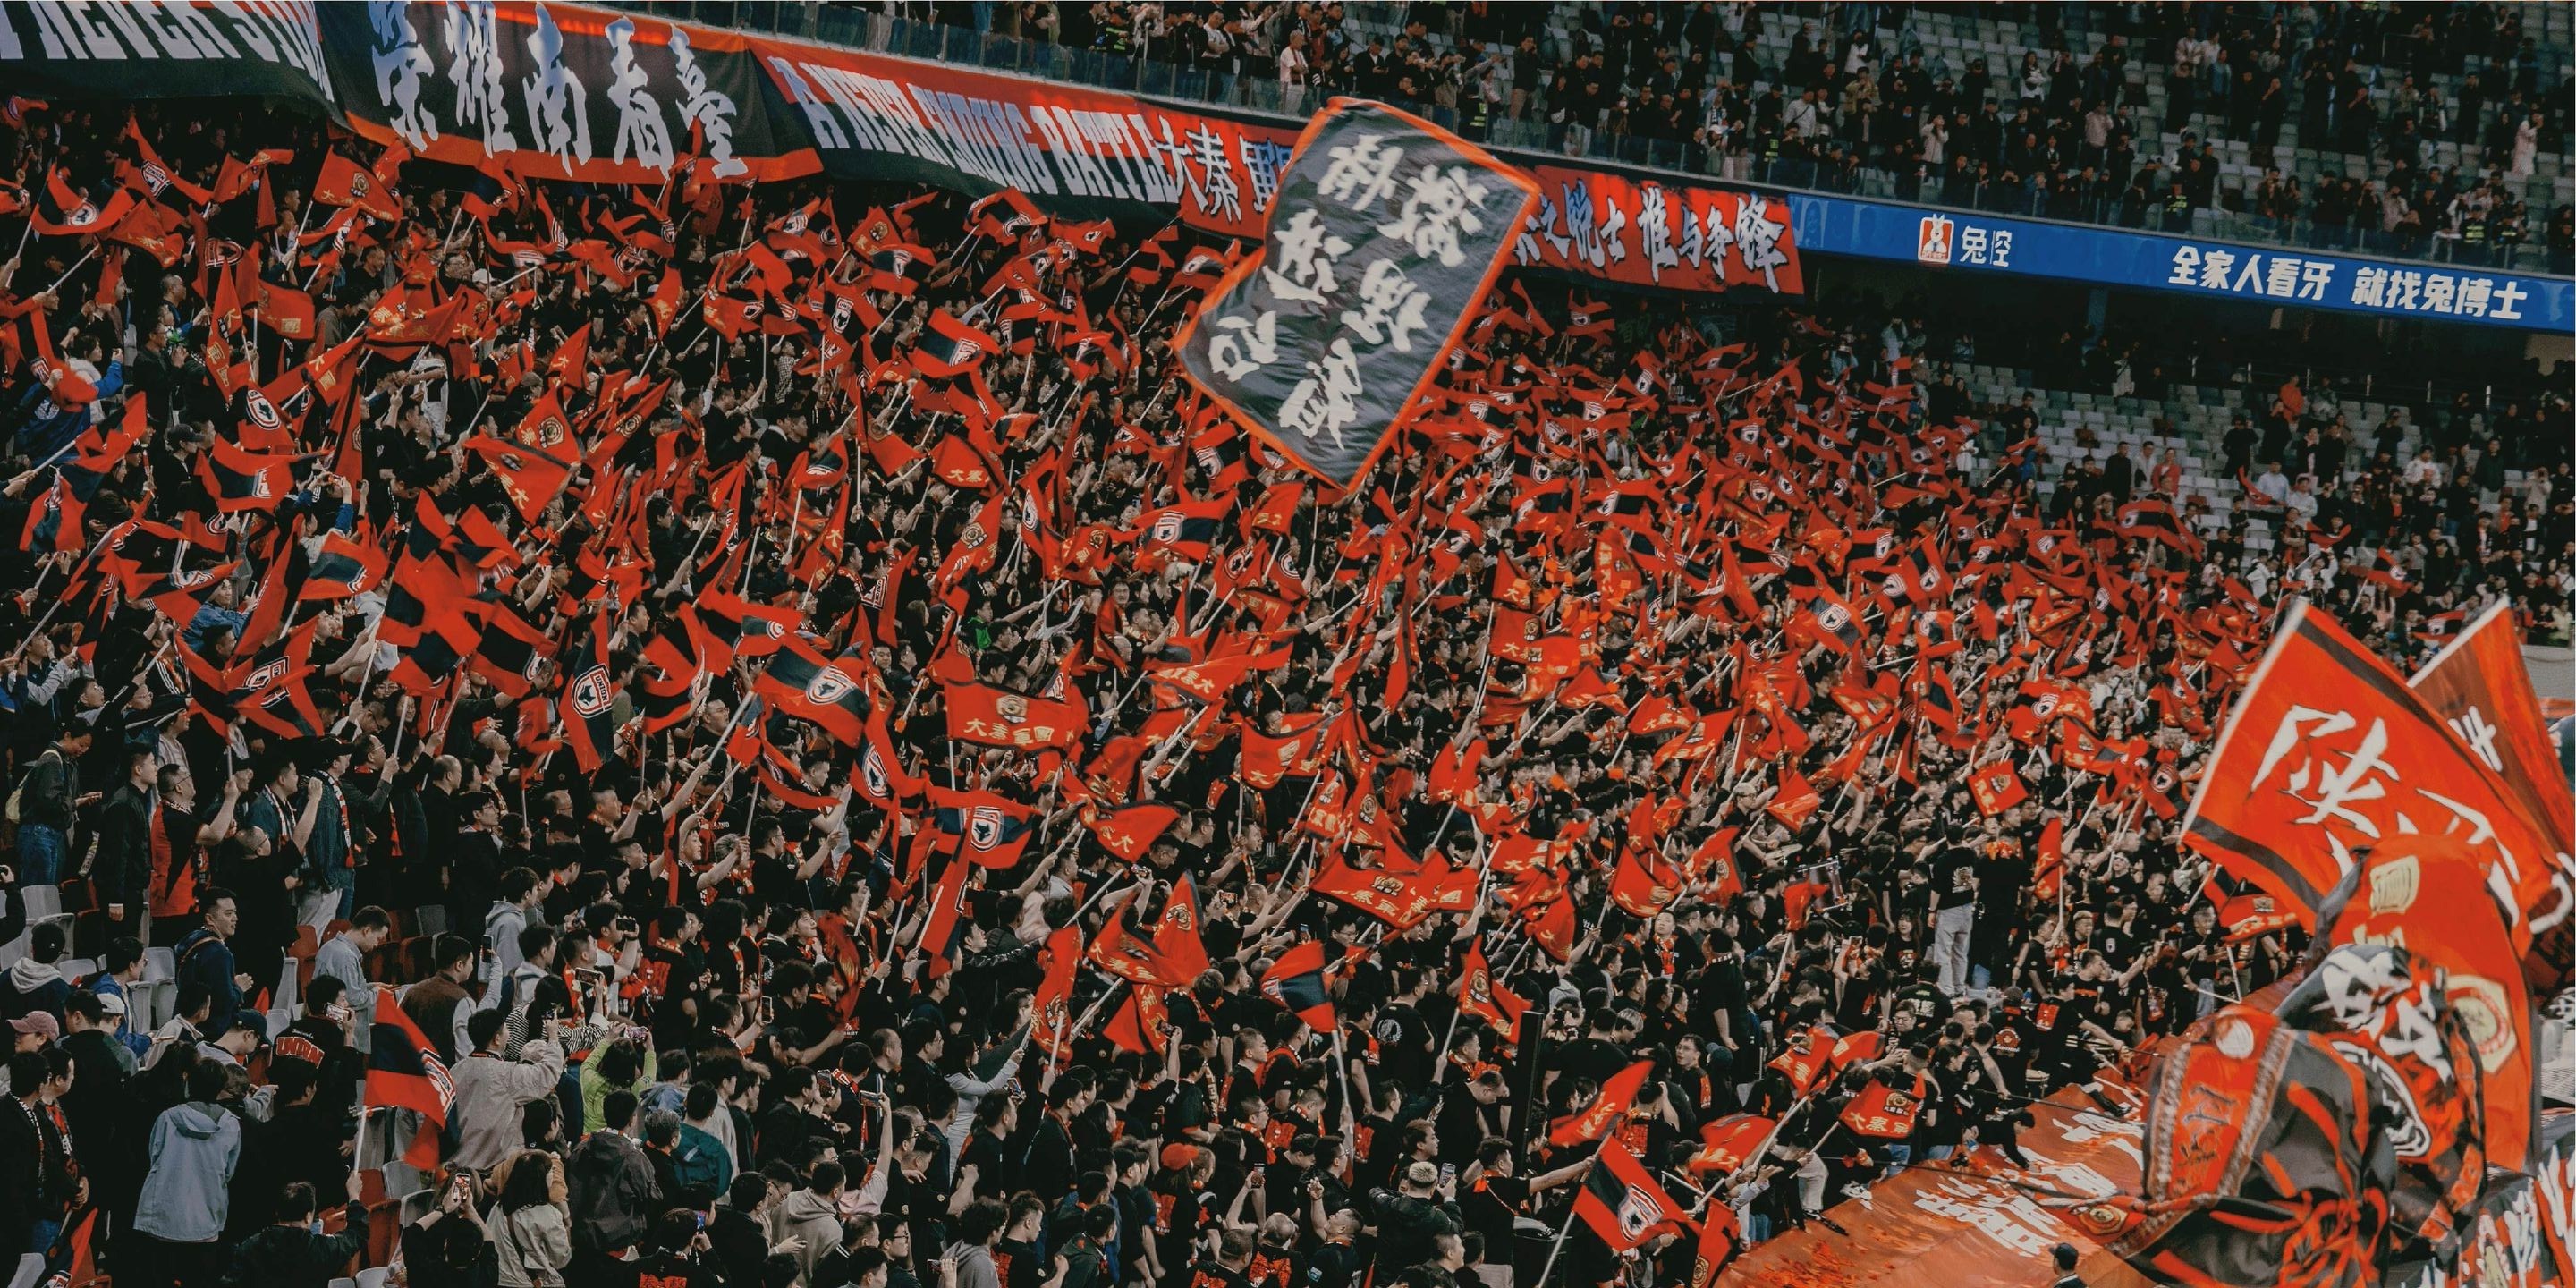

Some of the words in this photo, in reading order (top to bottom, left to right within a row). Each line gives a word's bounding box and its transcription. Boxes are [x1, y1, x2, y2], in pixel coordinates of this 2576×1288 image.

[767, 55, 850, 148] A
[798, 62, 955, 169] NEVER
[906, 82, 1058, 194] ENDING
[1030, 105, 1179, 203] BATTLE
[2167, 245, 2334, 301] 全家人看牙
[2351, 267, 2528, 319] 就找兔博士
[596, 675, 608, 701] UNION
[276, 1036, 325, 1069] UNION
